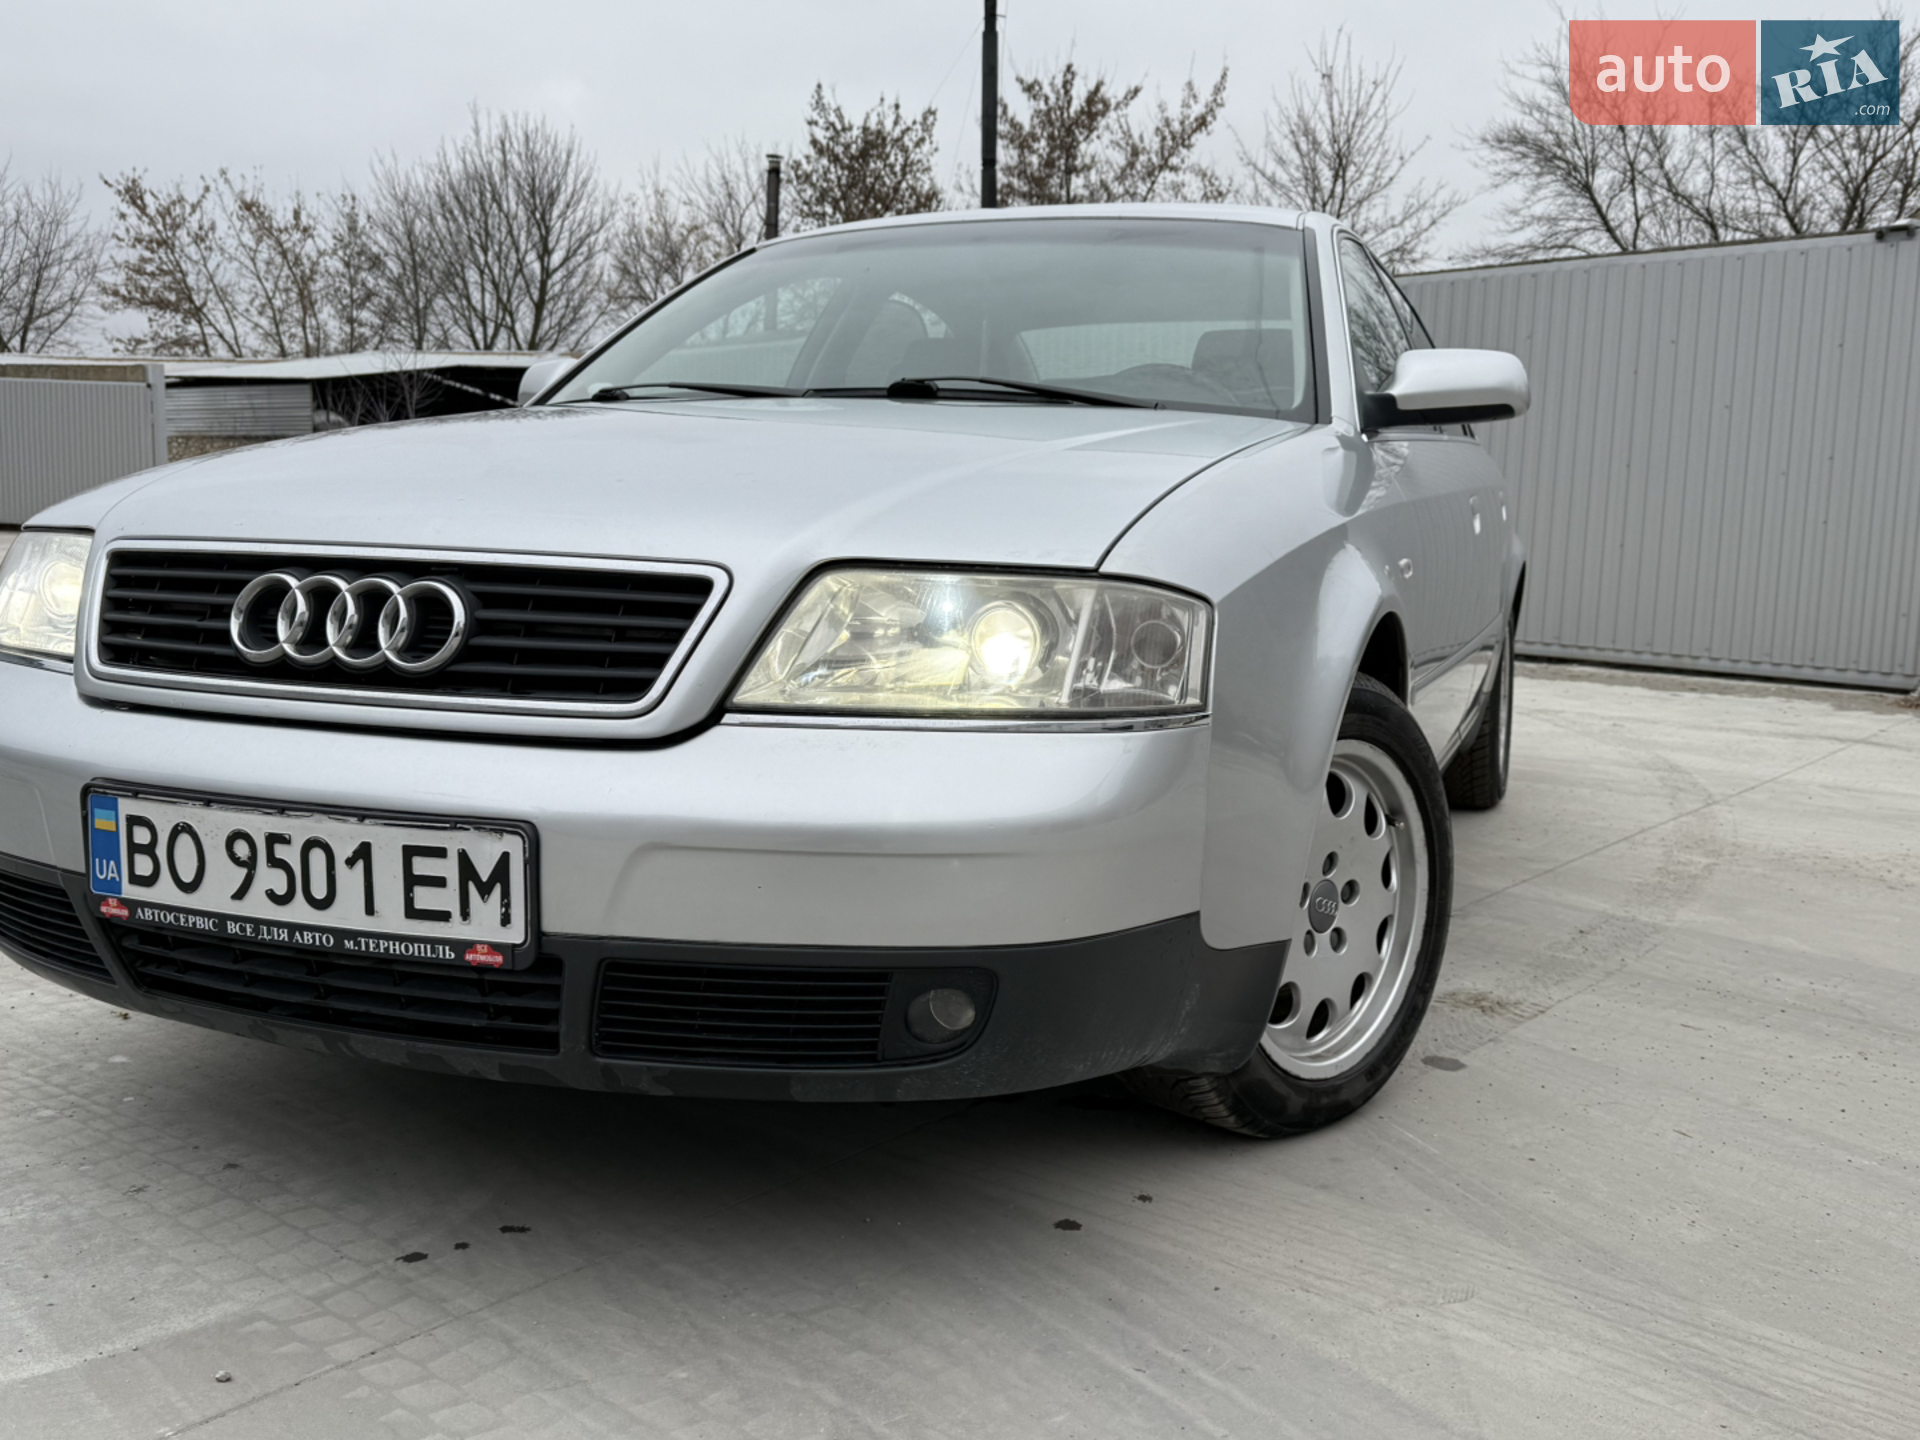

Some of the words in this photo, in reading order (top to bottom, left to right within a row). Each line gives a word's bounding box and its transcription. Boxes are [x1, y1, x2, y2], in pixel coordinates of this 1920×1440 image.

[95, 858, 120, 882] UA
[125, 813, 206, 894] BO
[225, 828, 376, 916] 9501
[402, 844, 511, 928] EM
[135, 907, 219, 931] АВТОСЕРВІС
[226, 921, 255, 937] ВСЕ
[258, 925, 289, 941] ДЛЯ
[292, 930, 334, 948] АВТО
